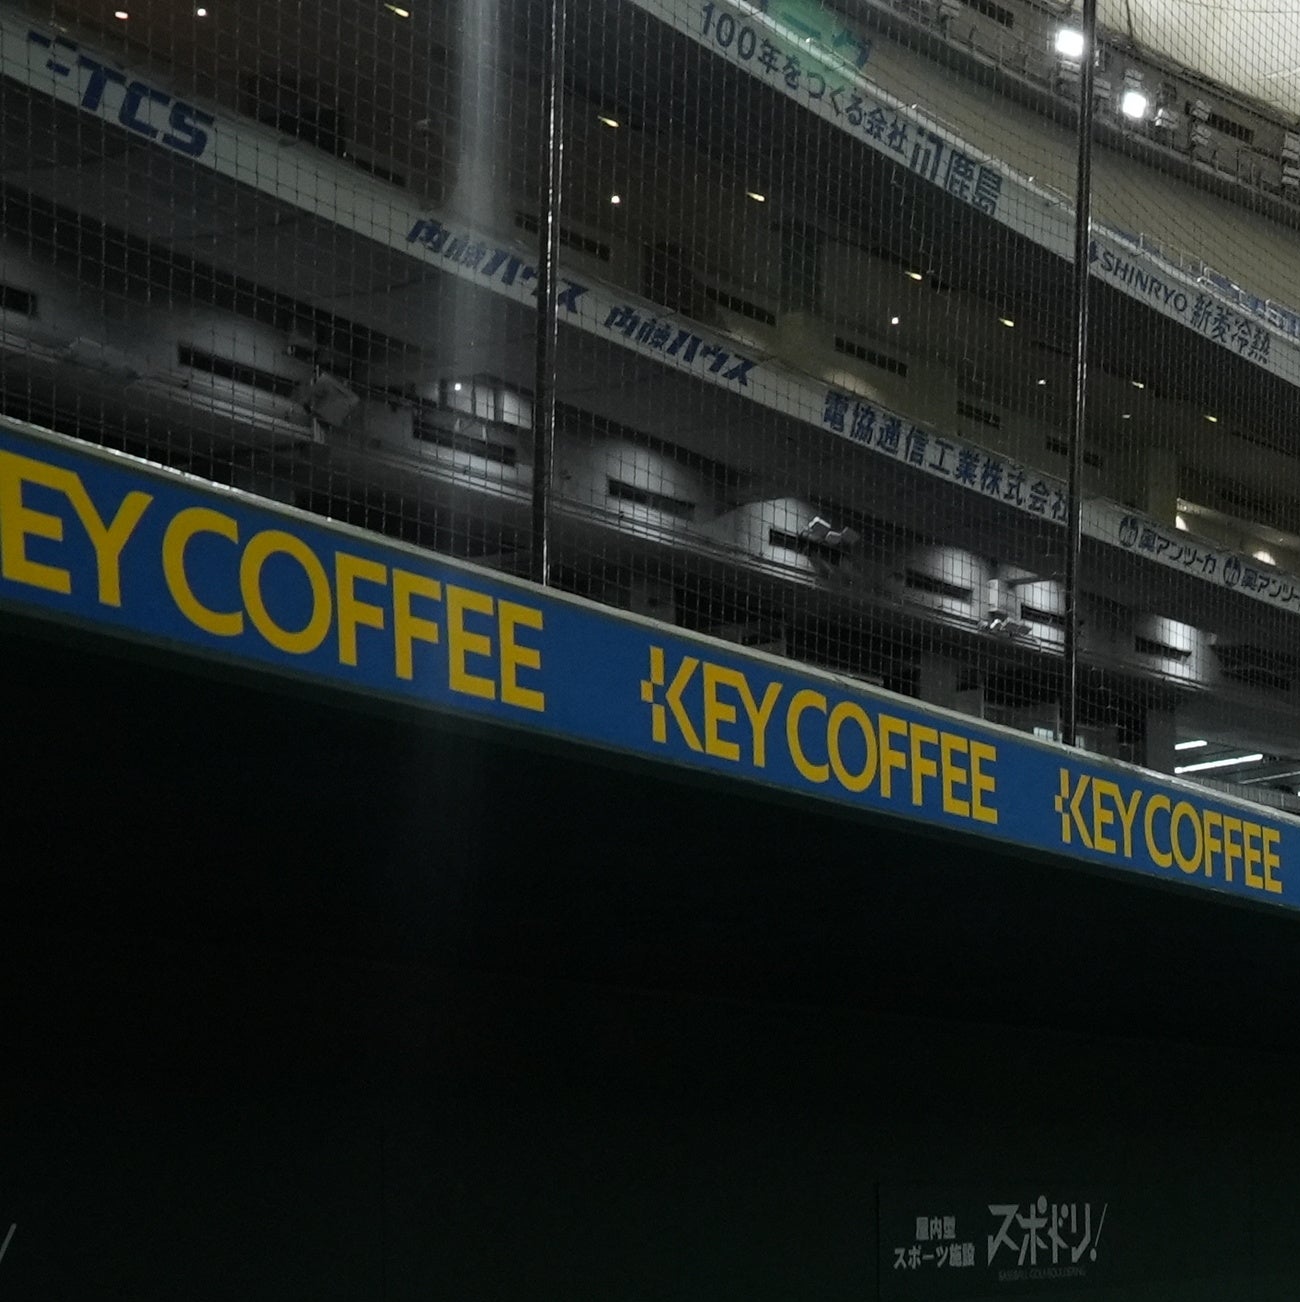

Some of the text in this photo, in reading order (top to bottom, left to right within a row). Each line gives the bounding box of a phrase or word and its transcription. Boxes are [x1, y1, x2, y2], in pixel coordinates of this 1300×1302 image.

[1101, 251, 1270, 363] SHINRYO 新菱冷熱
[162, 507, 546, 711] COFFEE
[893, 1242, 976, 1270] スポーツ施設
